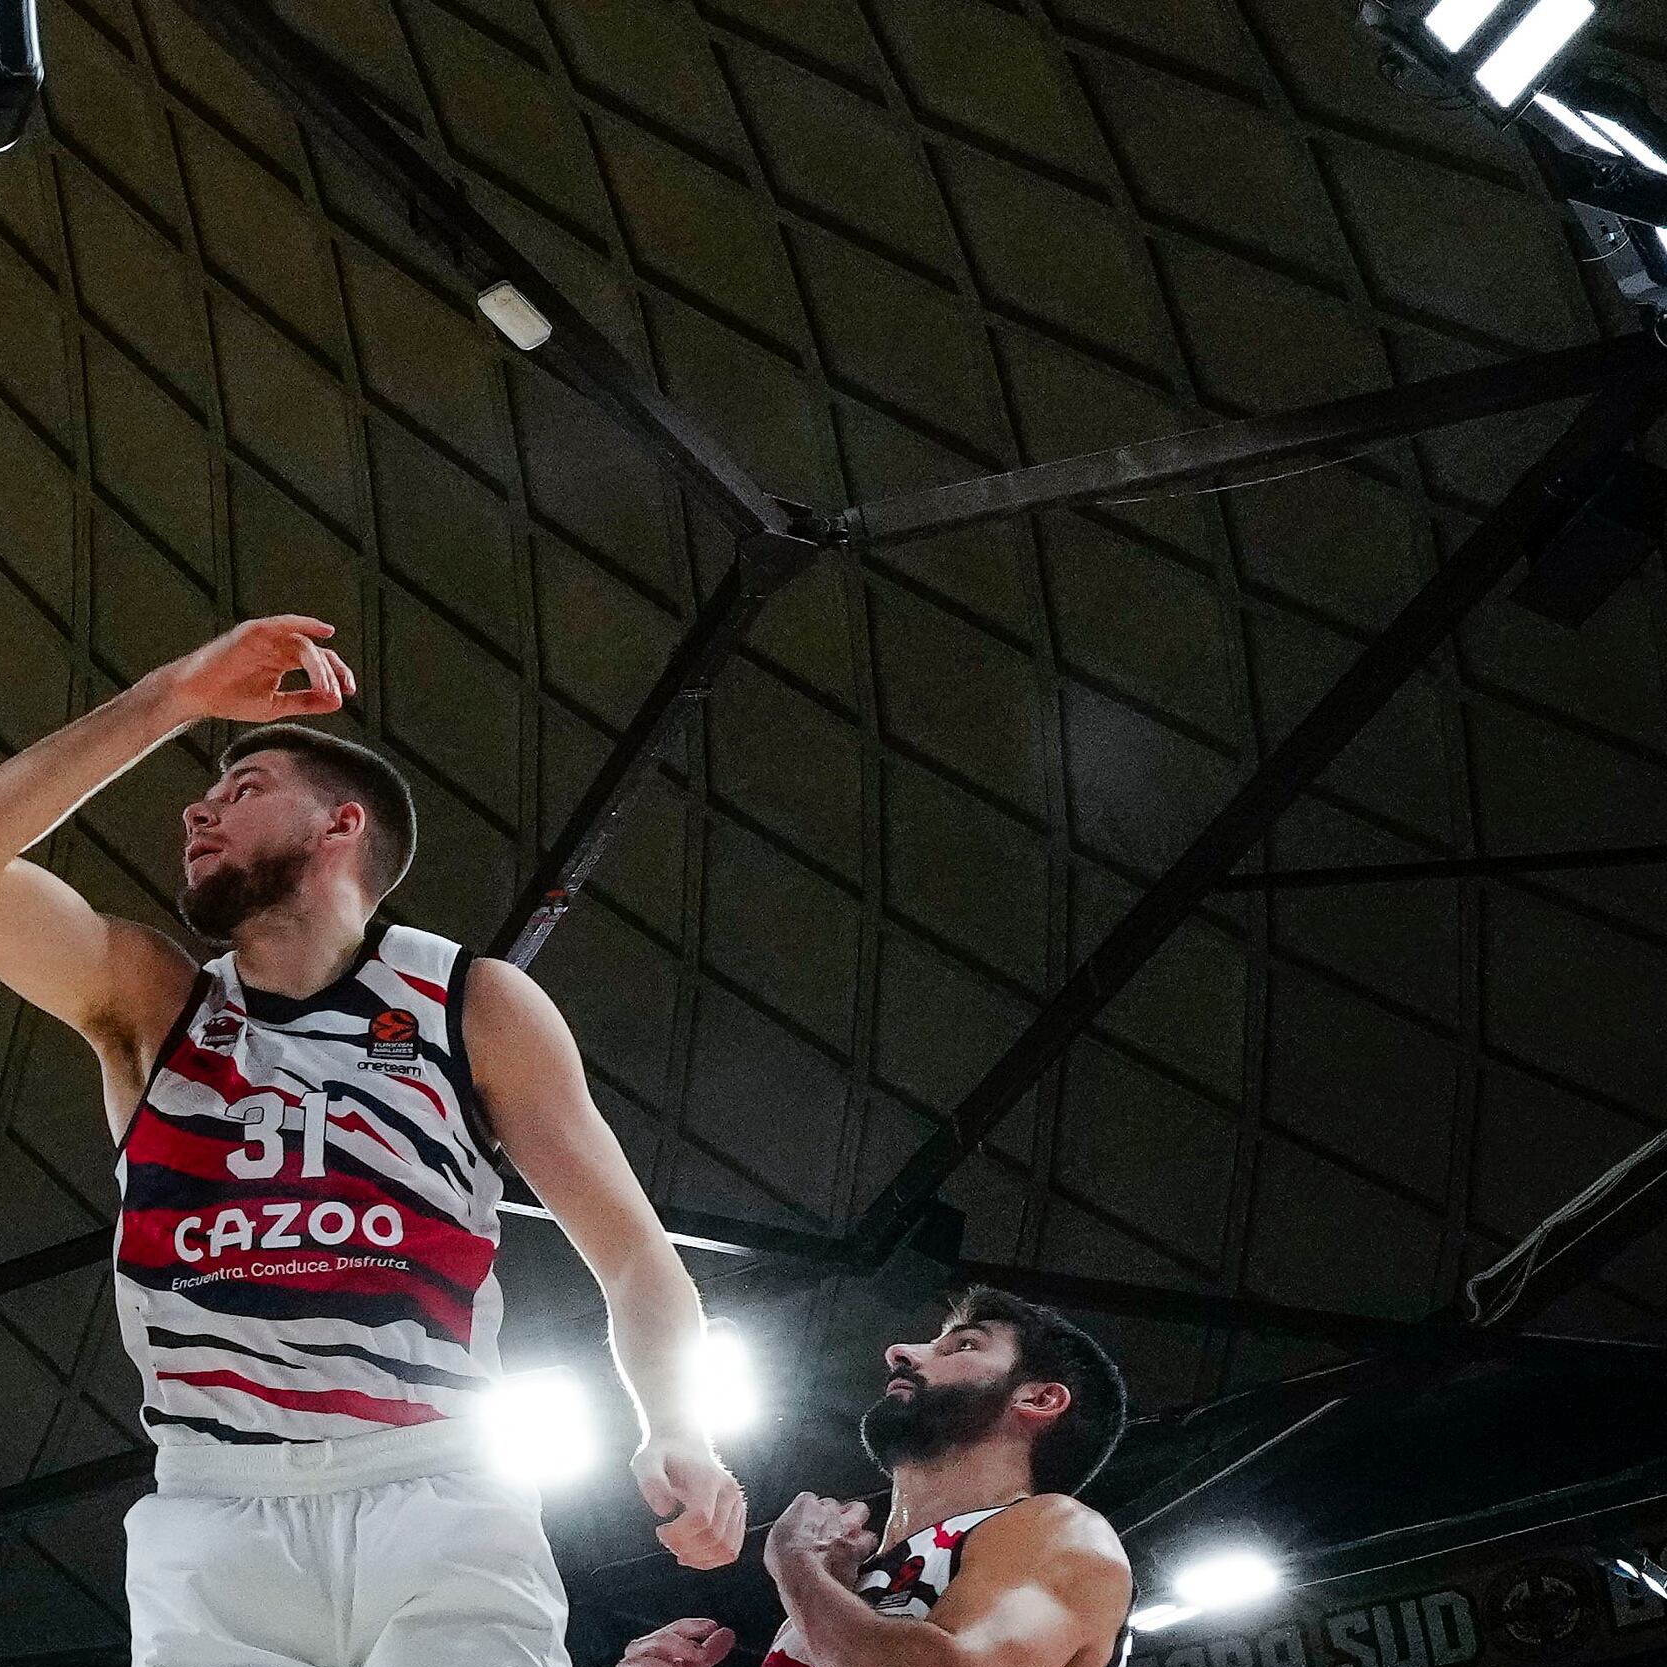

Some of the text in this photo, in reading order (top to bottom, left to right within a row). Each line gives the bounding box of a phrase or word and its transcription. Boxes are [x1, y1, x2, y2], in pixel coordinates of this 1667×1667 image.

[356, 1059, 423, 1078] oneteam
[225, 1089, 330, 1180] 31
[173, 1200, 405, 1264] CAZOO
[170, 1255, 412, 1292] Encuentra. Conduce. Disfruta.
